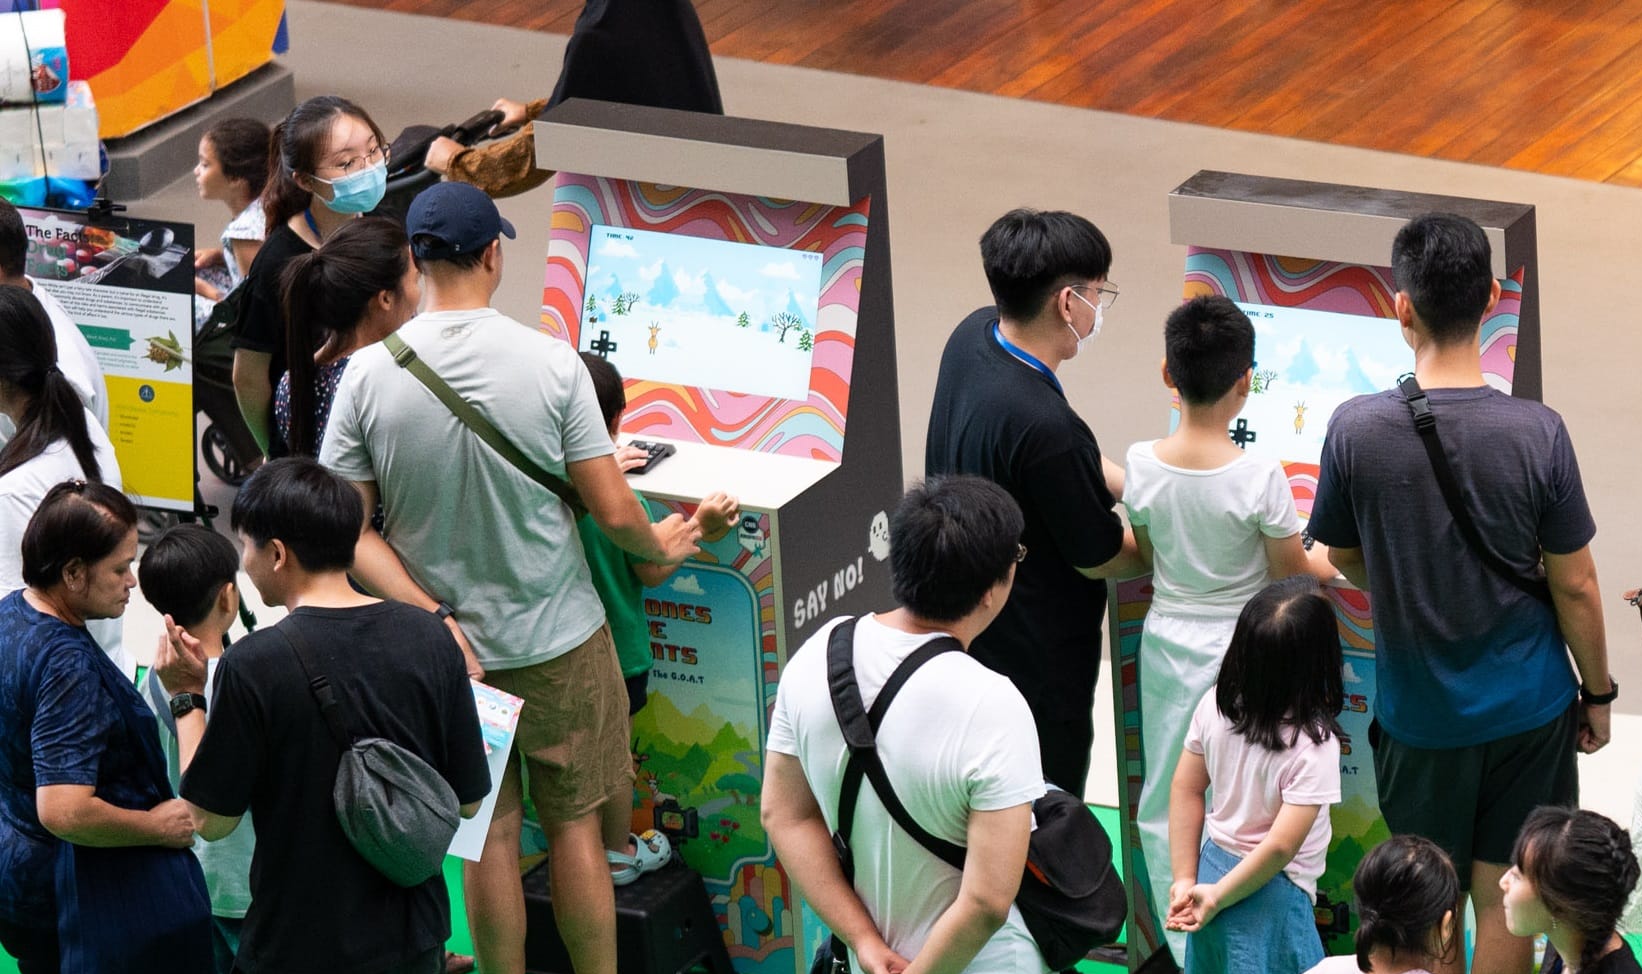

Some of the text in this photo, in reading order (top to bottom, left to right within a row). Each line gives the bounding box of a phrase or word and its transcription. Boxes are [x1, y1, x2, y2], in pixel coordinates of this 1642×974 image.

[26, 225, 52, 239] The
[27, 240, 67, 261] Drug
[794, 556, 864, 630] SAY NO!
[645, 598, 713, 625] ONES
[653, 670, 705, 685] The G.O.A.T
